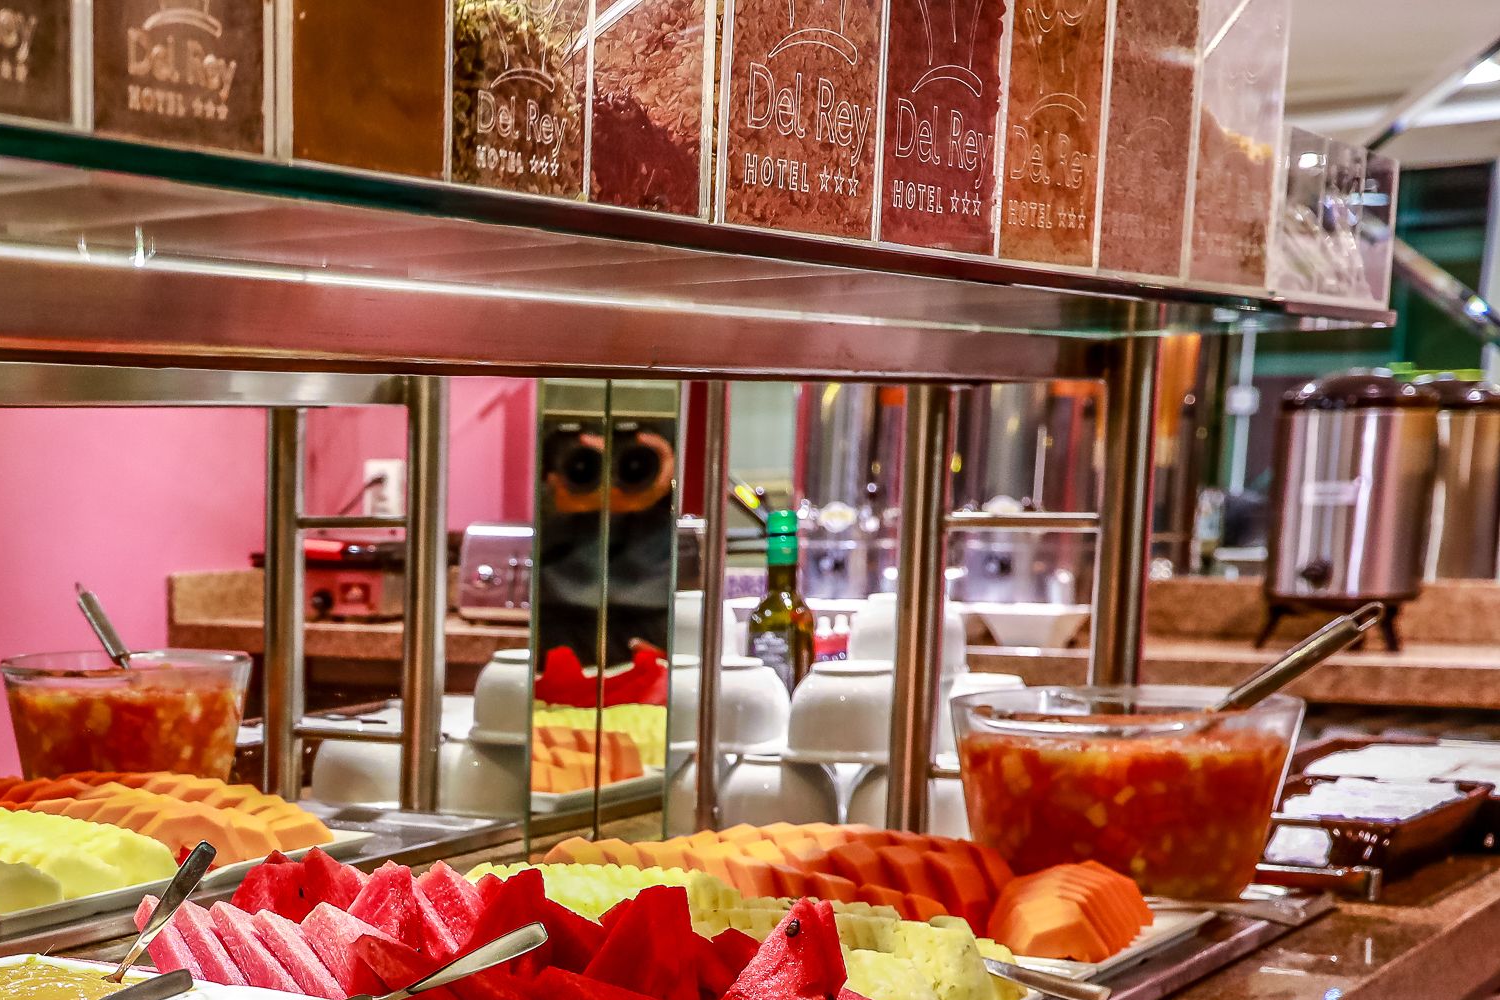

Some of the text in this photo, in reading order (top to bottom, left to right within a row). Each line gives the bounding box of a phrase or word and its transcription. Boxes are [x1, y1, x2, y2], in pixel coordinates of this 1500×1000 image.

[127, 27, 237, 102] Del Rey
[127, 84, 186, 117] HOTEL
[477, 89, 567, 158] Del Rey
[747, 61, 871, 167] Del Rey
[476, 144, 524, 174] HOTEL
[896, 97, 993, 189] Del Rey
[1010, 124, 1050, 185] Del
[744, 153, 809, 192] HOTEL
[893, 179, 943, 214] HOTEL
[1008, 199, 1052, 229] HOTEL
